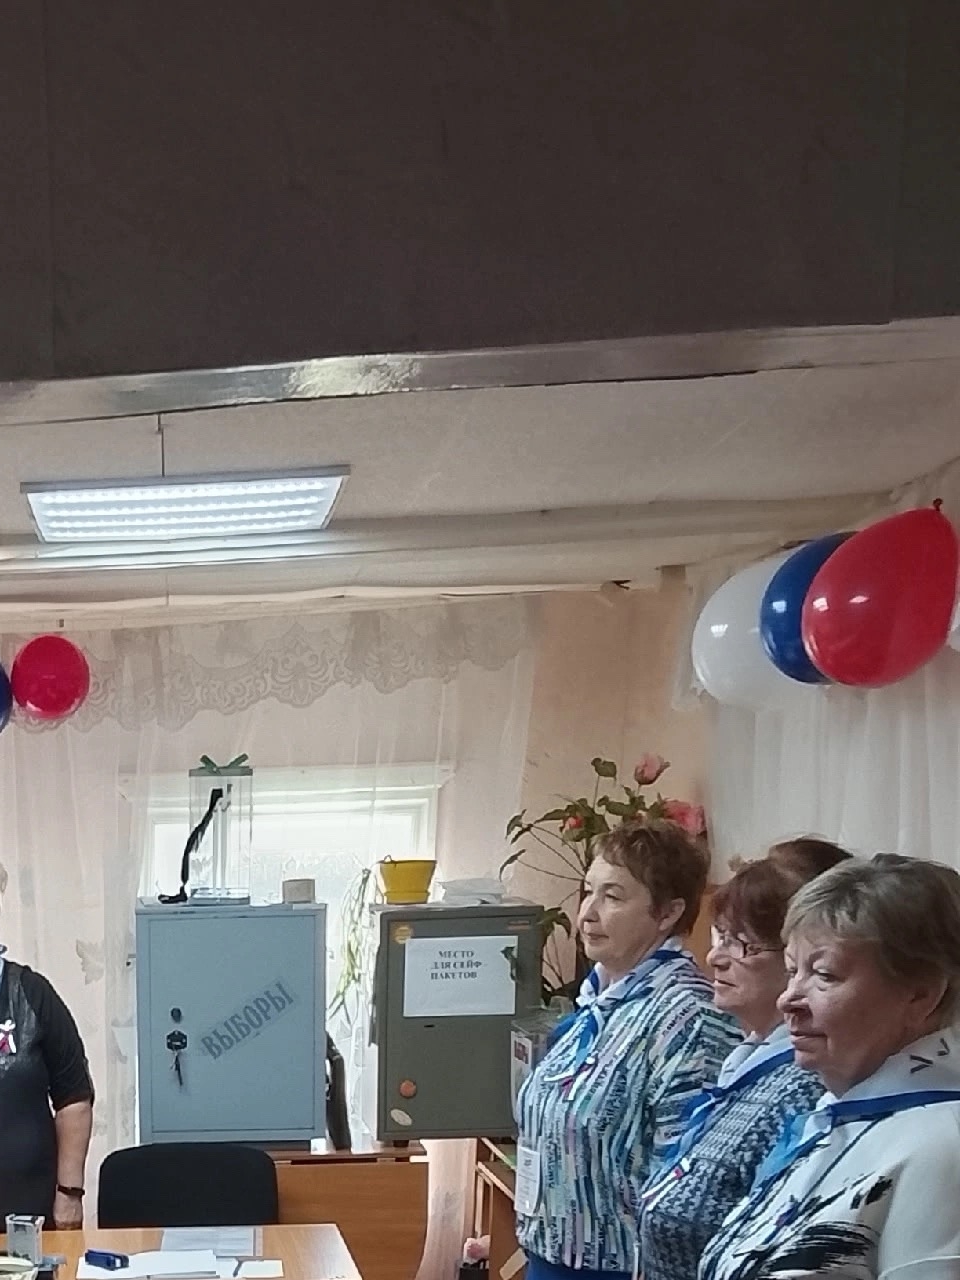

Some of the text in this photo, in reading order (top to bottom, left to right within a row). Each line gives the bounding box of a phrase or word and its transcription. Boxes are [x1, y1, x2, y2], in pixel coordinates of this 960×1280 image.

[438, 950, 475, 959] МЕСТО
[430, 961, 451, 970] ДЛЯ
[430, 971, 477, 980] ПАКЕТОВ
[201, 982, 294, 1060] ВЫБОРЫ
